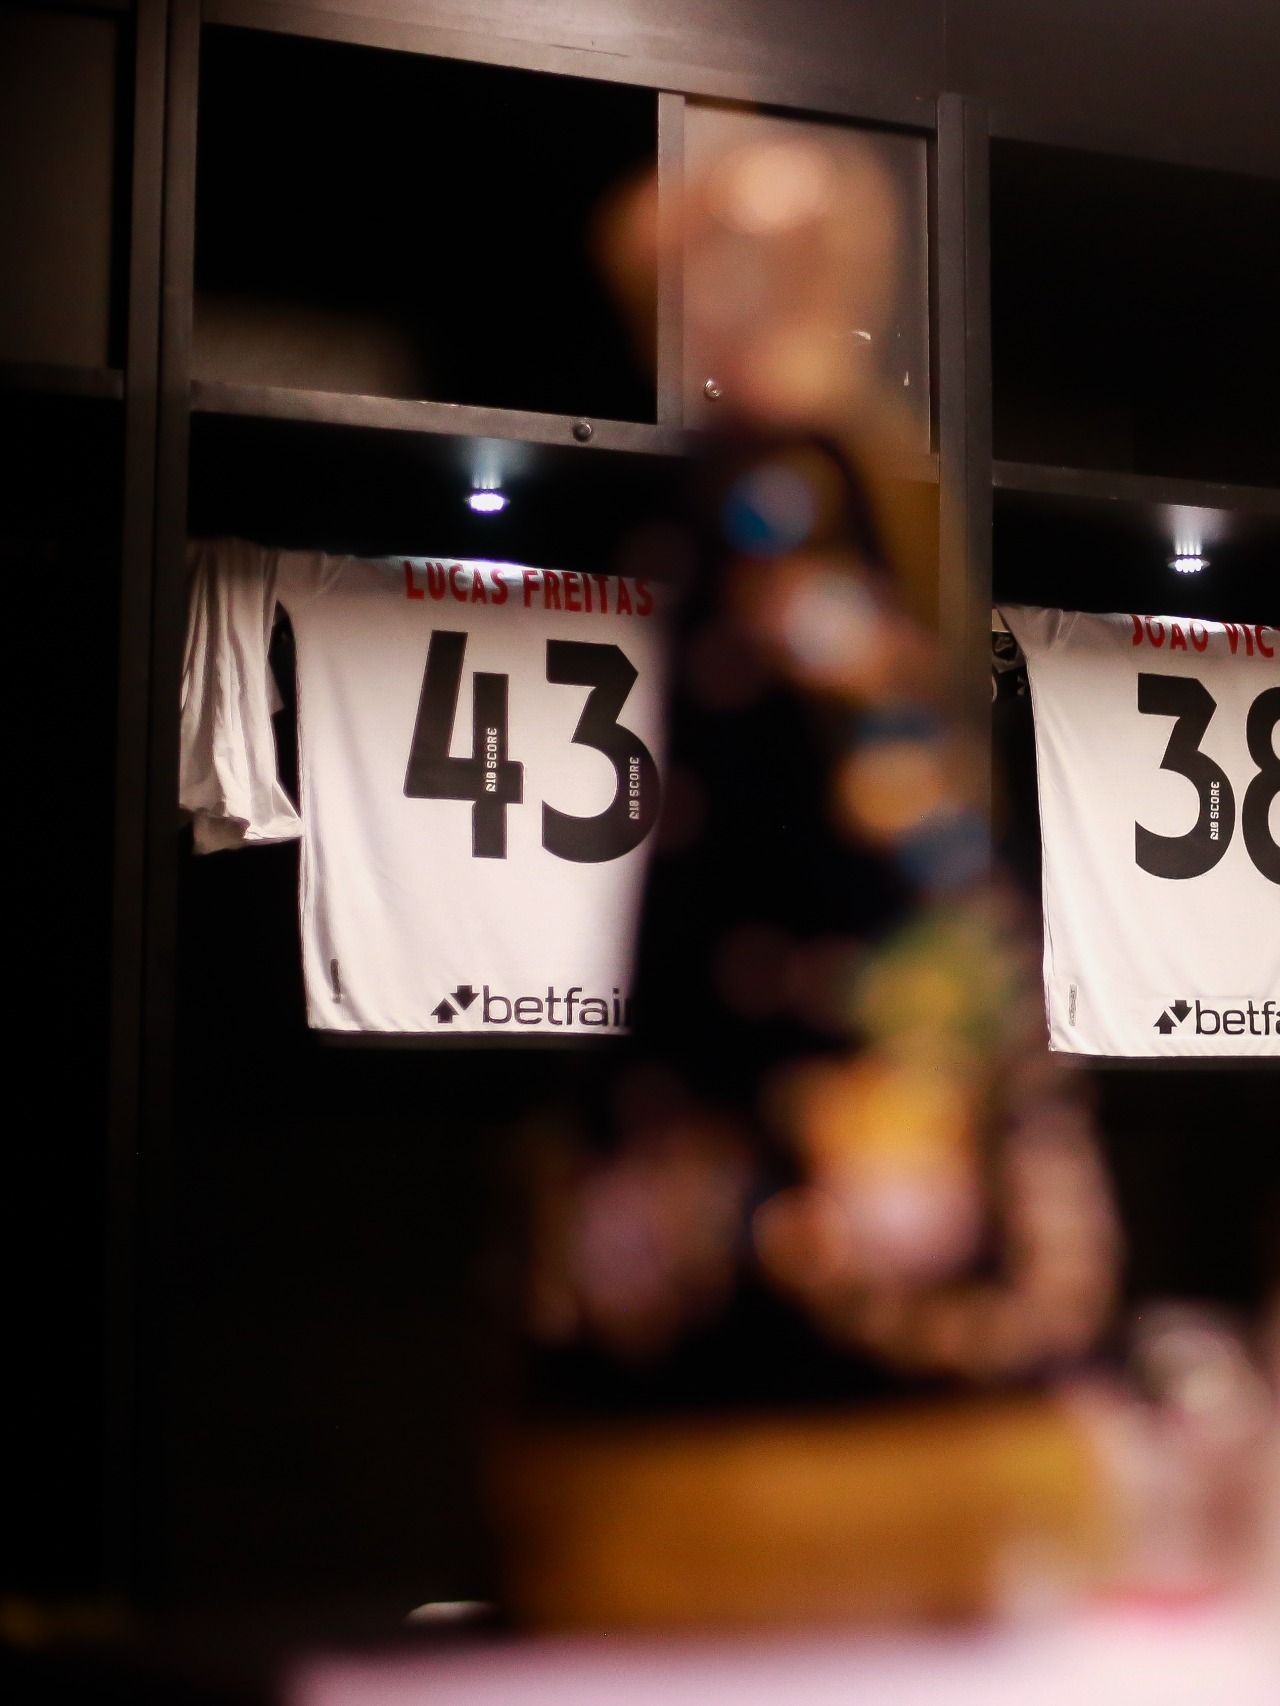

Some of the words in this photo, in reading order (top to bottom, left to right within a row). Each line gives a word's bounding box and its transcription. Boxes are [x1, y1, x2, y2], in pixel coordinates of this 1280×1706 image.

[403, 559, 509, 606] LUCAS
[520, 568, 655, 617] FREITAS
[403, 630, 660, 863] 43
[486, 727, 498, 769] SCORE
[629, 757, 640, 797] SCORE
[1210, 781, 1220, 819] SCORE
